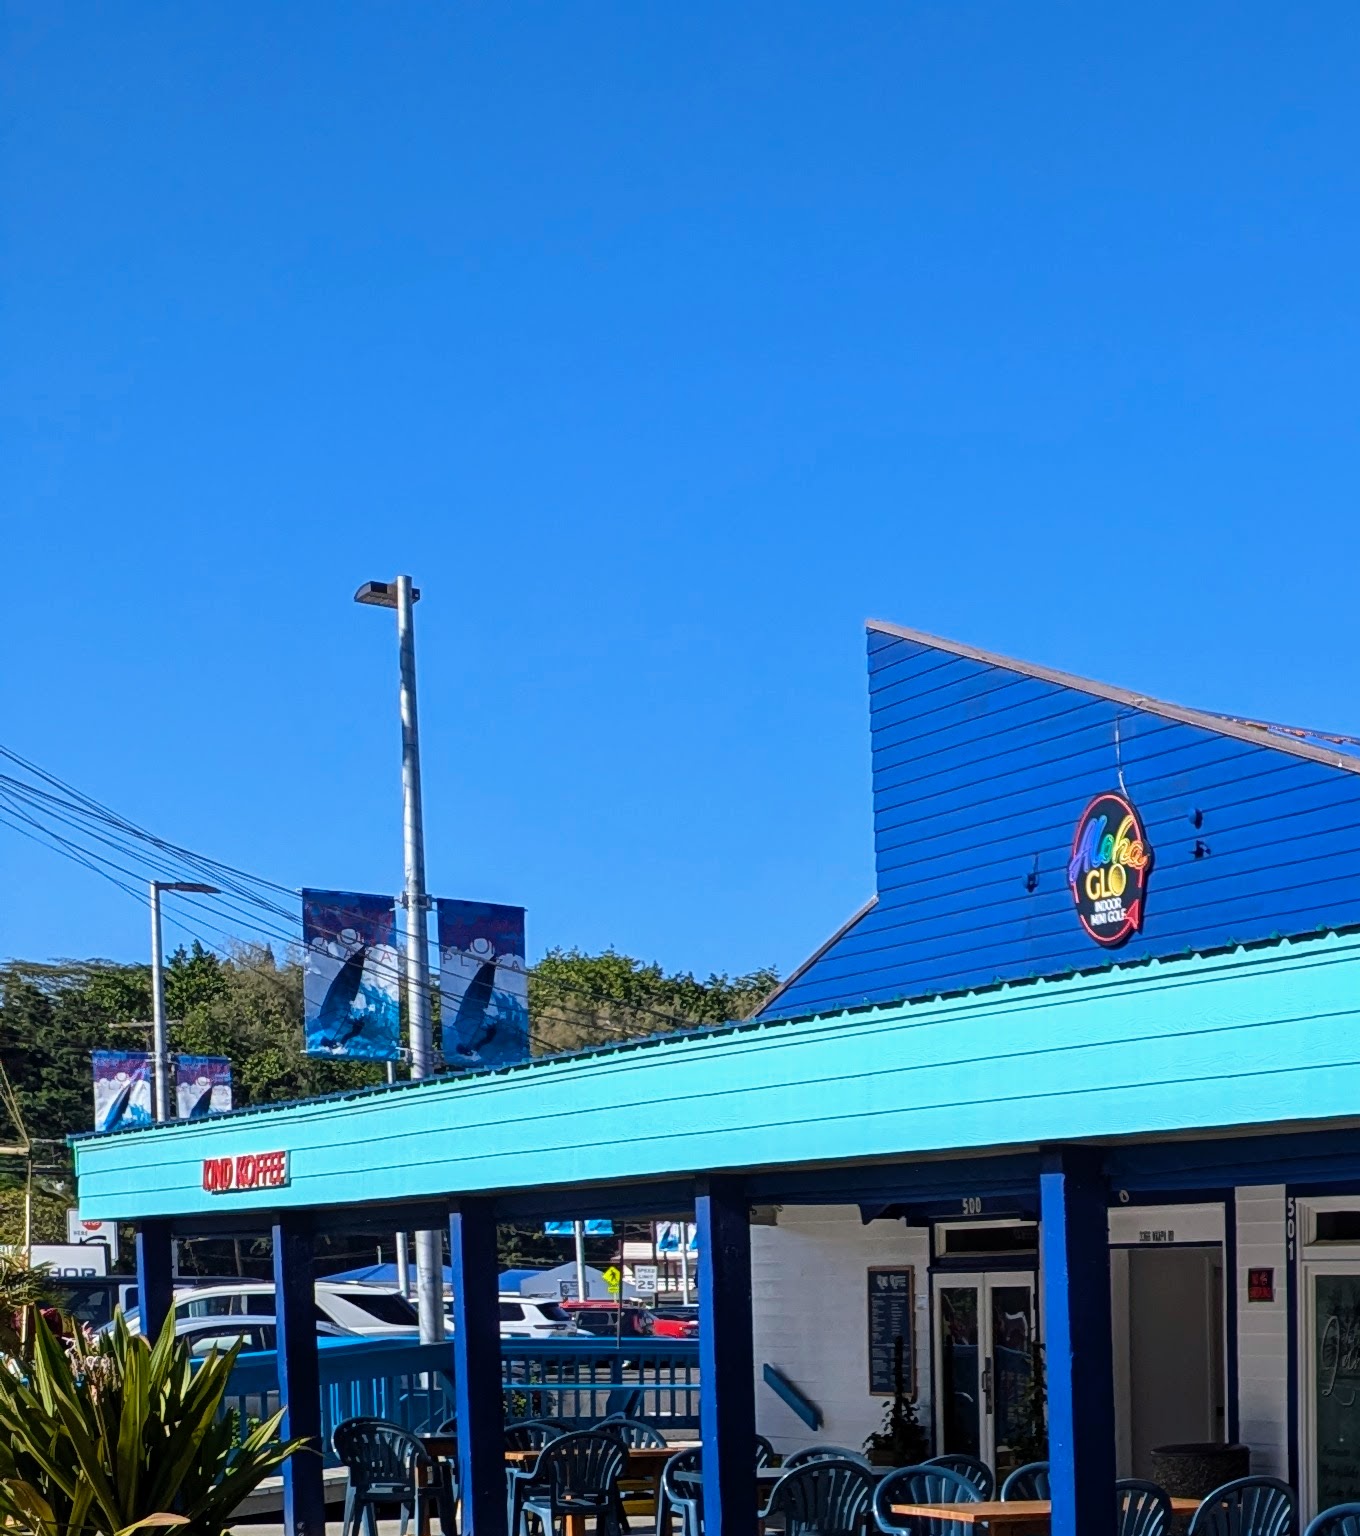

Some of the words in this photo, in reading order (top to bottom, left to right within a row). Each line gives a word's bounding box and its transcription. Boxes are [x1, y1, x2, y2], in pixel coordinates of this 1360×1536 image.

[1069, 815, 1151, 886] Aloha
[1085, 863, 1127, 901] GLO
[1090, 912, 1107, 926] MINI
[1107, 908, 1127, 924] GOLF
[1094, 897, 1122, 914] INDOOR
[203, 1157, 233, 1192] KIND
[235, 1151, 286, 1188] KOFFEE
[961, 1196, 982, 1215] 500
[1287, 1196, 1296, 1261] 501
[637, 1280, 656, 1290] 25
